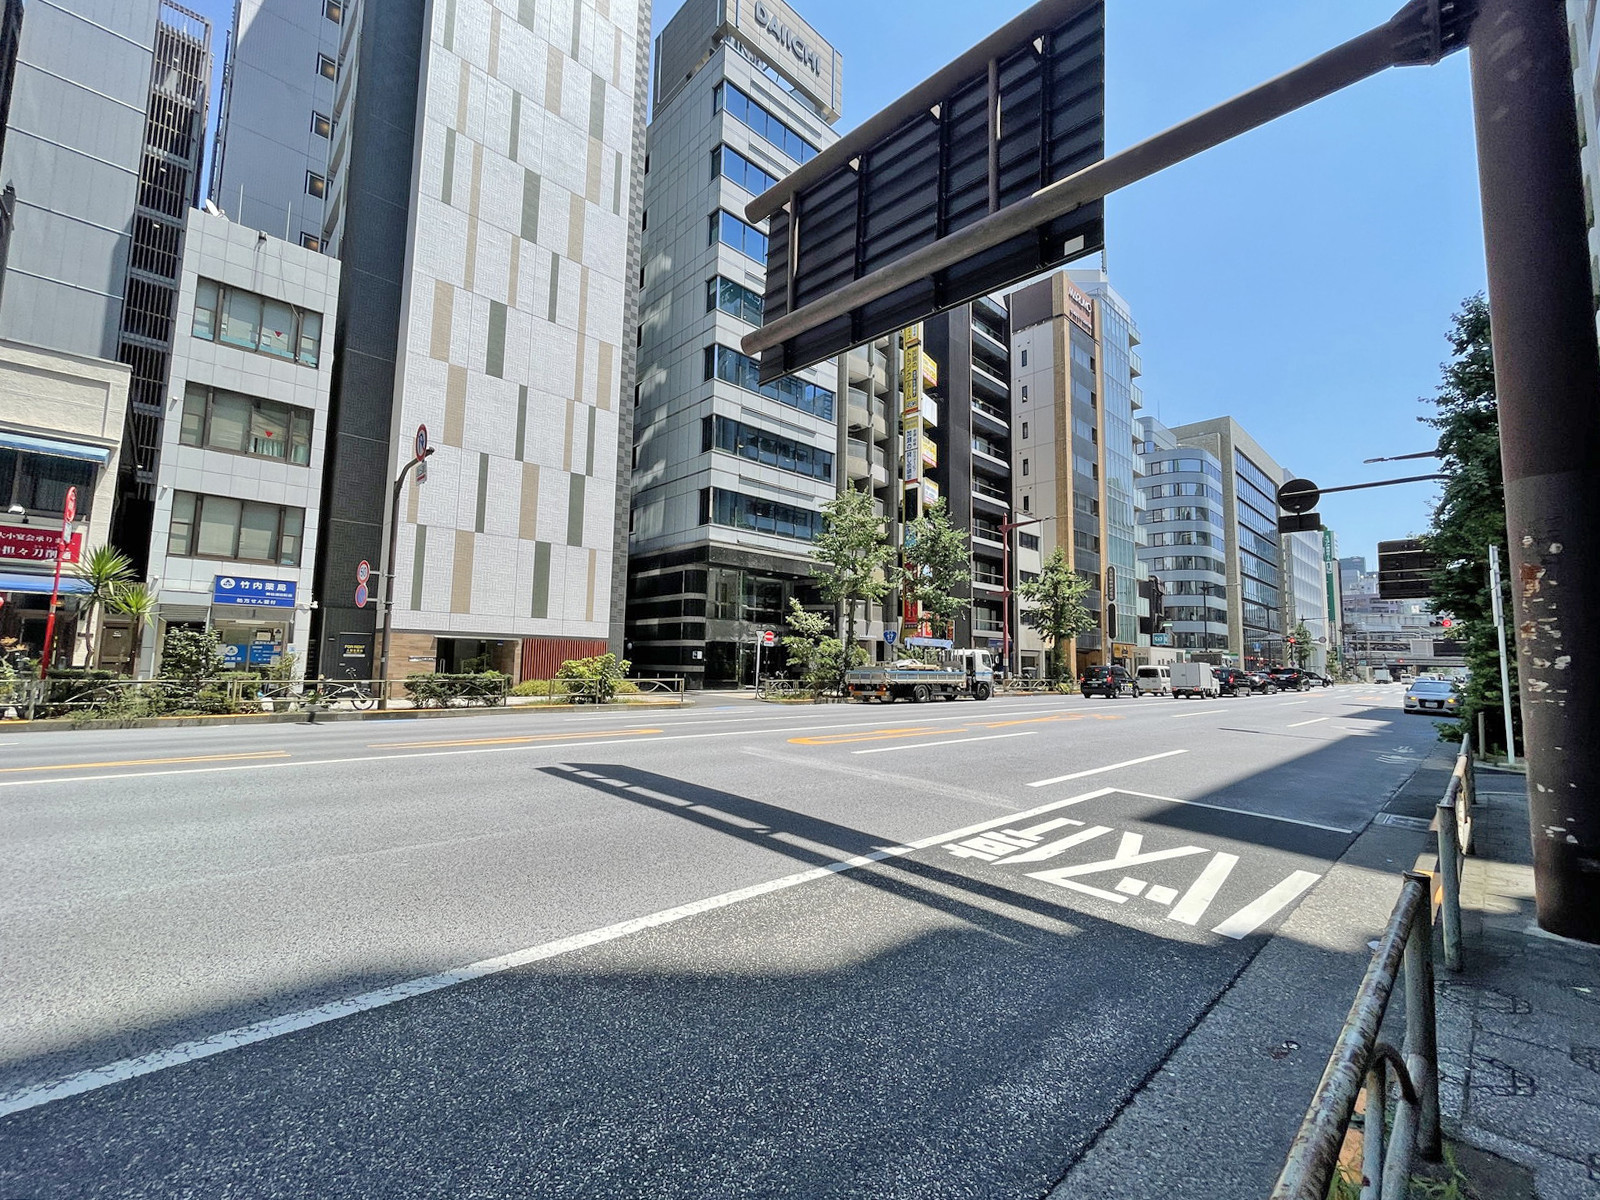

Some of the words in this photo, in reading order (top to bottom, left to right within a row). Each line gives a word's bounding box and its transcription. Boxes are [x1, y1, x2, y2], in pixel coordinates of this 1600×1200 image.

[754, 0, 821, 77] DAIICHI
[240, 580, 287, 592] 竹内薬局
[941, 817, 1322, 940] バス停
